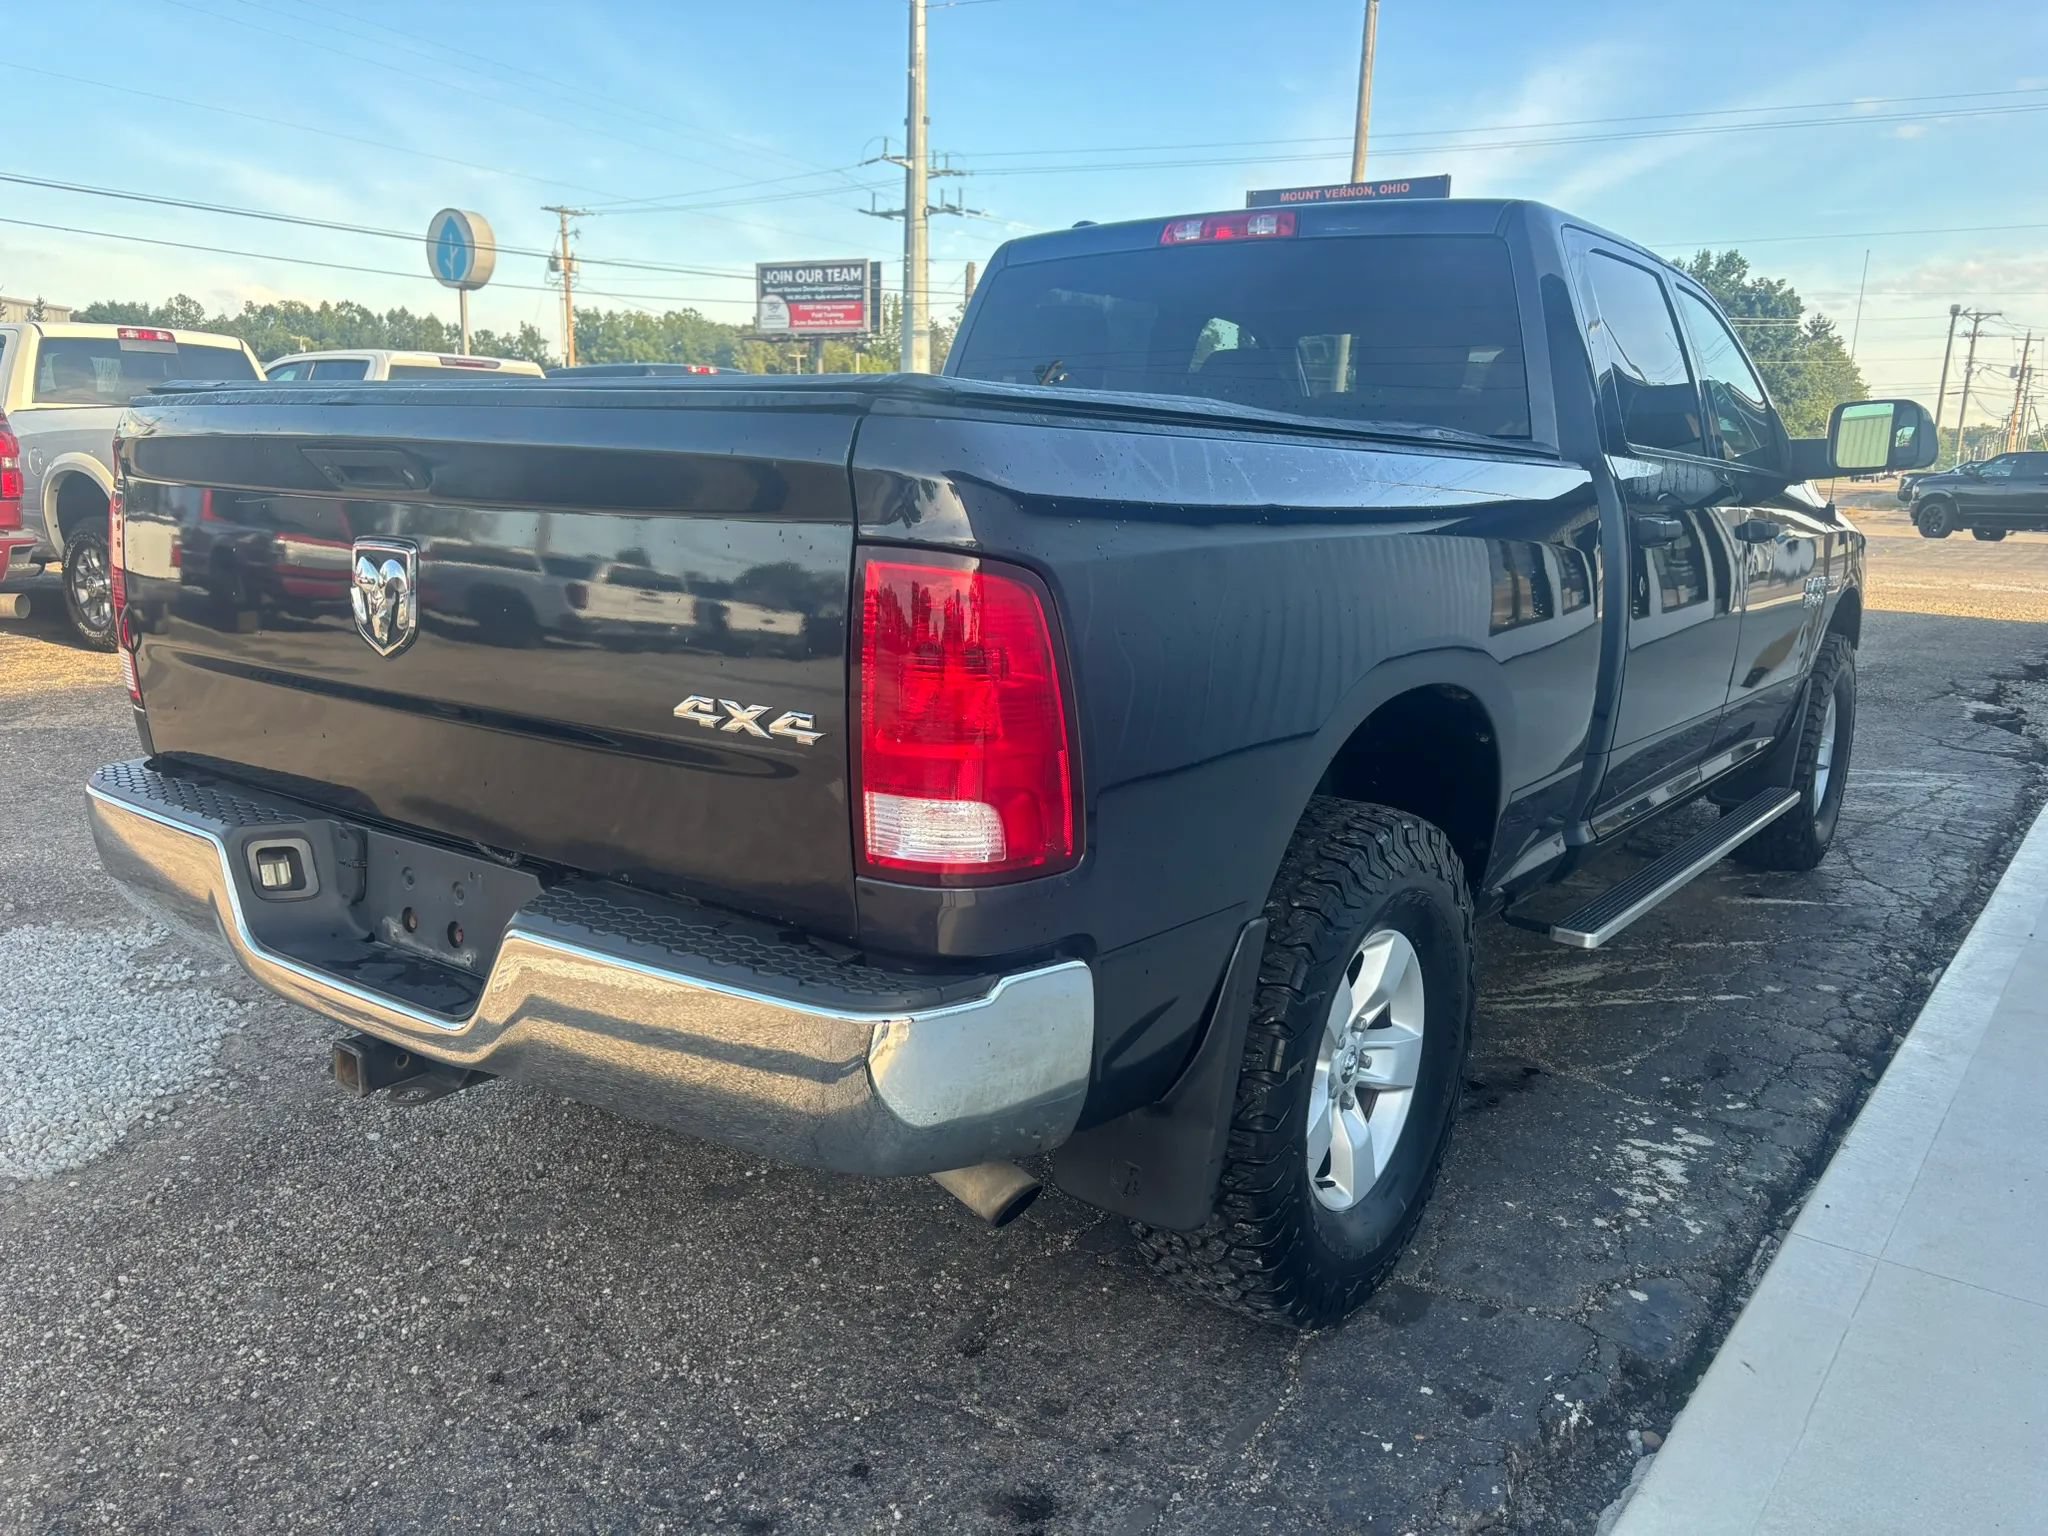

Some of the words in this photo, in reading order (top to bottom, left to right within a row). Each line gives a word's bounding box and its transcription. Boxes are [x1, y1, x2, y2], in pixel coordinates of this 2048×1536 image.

[1280, 190, 1321, 201] MOUNT
[1324, 187, 1376, 199] VERNON,
[1379, 183, 1410, 194] OHIO
[763, 270, 793, 284] JOIN
[795, 269, 824, 283] OUR
[826, 267, 862, 282] TEAM
